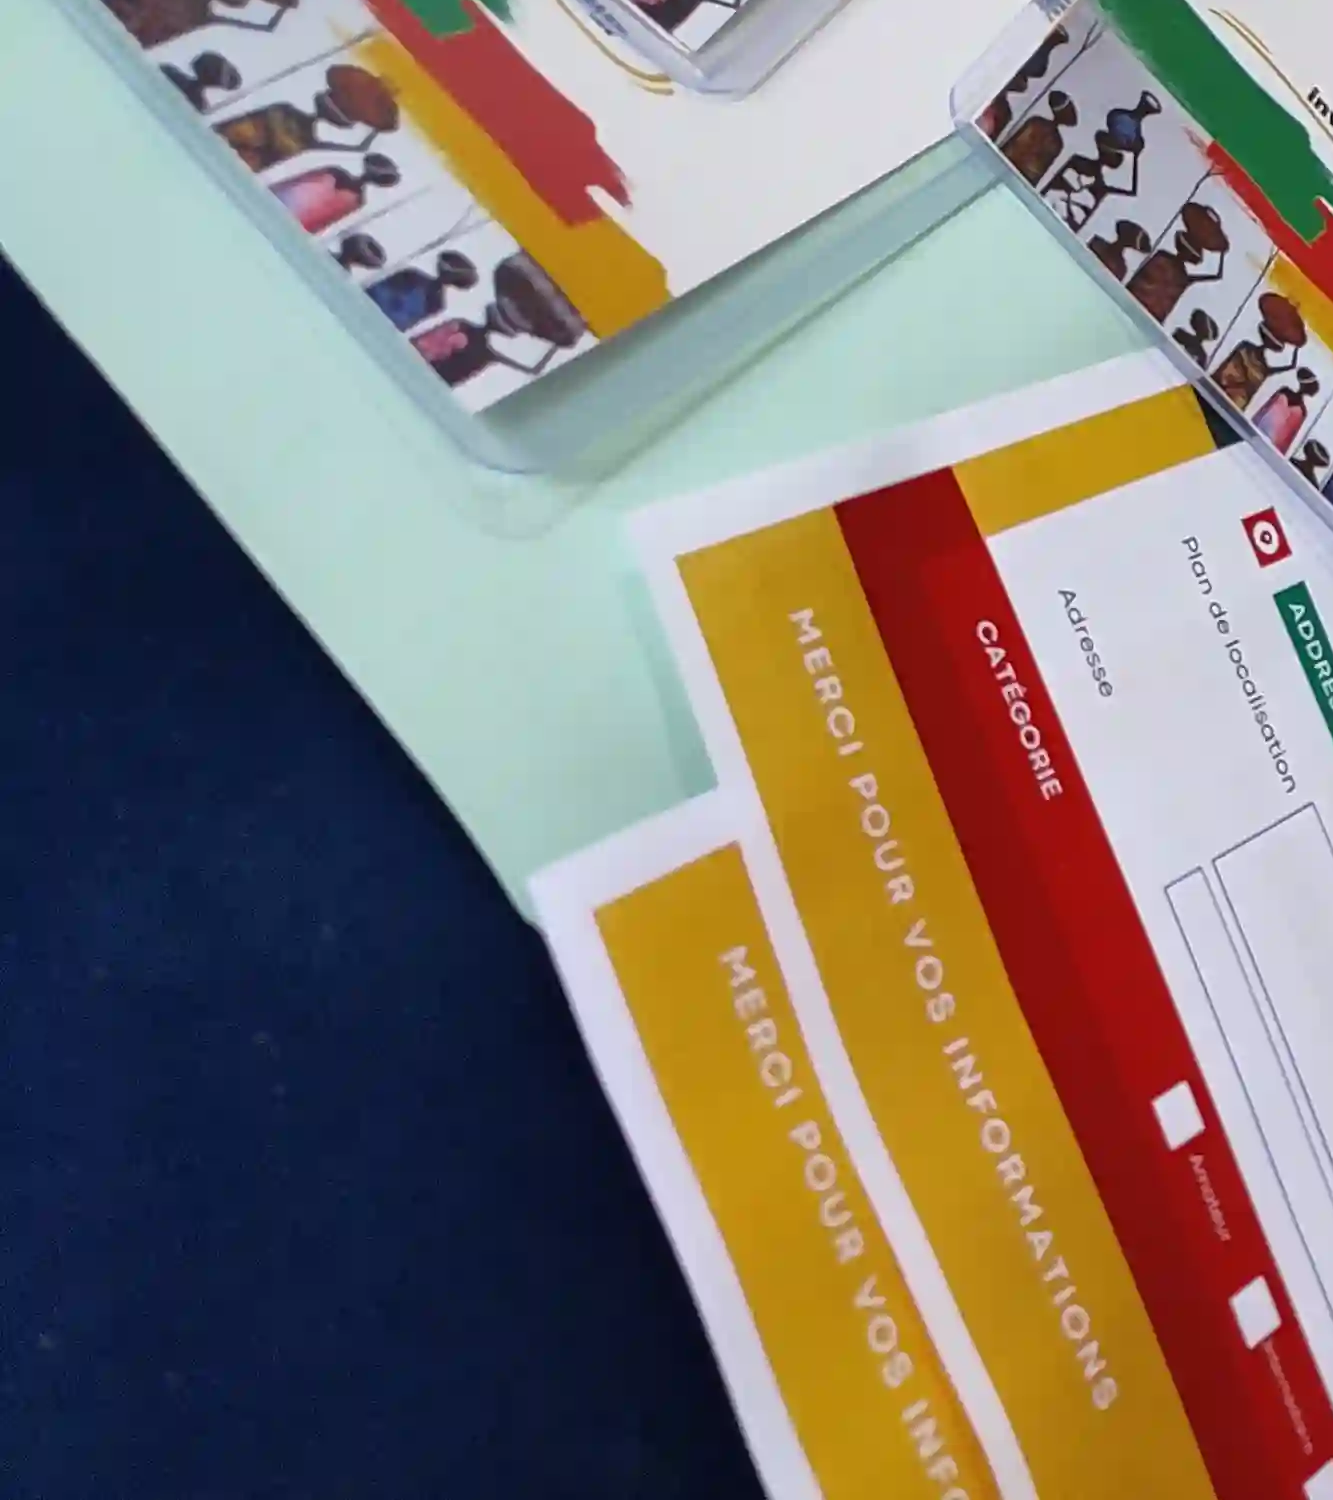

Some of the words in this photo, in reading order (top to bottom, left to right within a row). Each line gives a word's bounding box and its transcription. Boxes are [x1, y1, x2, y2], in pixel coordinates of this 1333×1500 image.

[976, 619, 1063, 800] CATÉGORIE
[1058, 588, 1115, 699] Adresse
[1181, 535, 1214, 595] Plan
[1208, 601, 1231, 636] de
[1225, 638, 1298, 794] localisation
[788, 607, 863, 757] MERCI
[848, 772, 917, 905] POUR
[902, 919, 957, 1025] VOS
[942, 1036, 1121, 1412] INFORMATIONS
[719, 944, 802, 1109] MERCI
[789, 1121, 864, 1264] POUR
[853, 1275, 915, 1390] VOS
